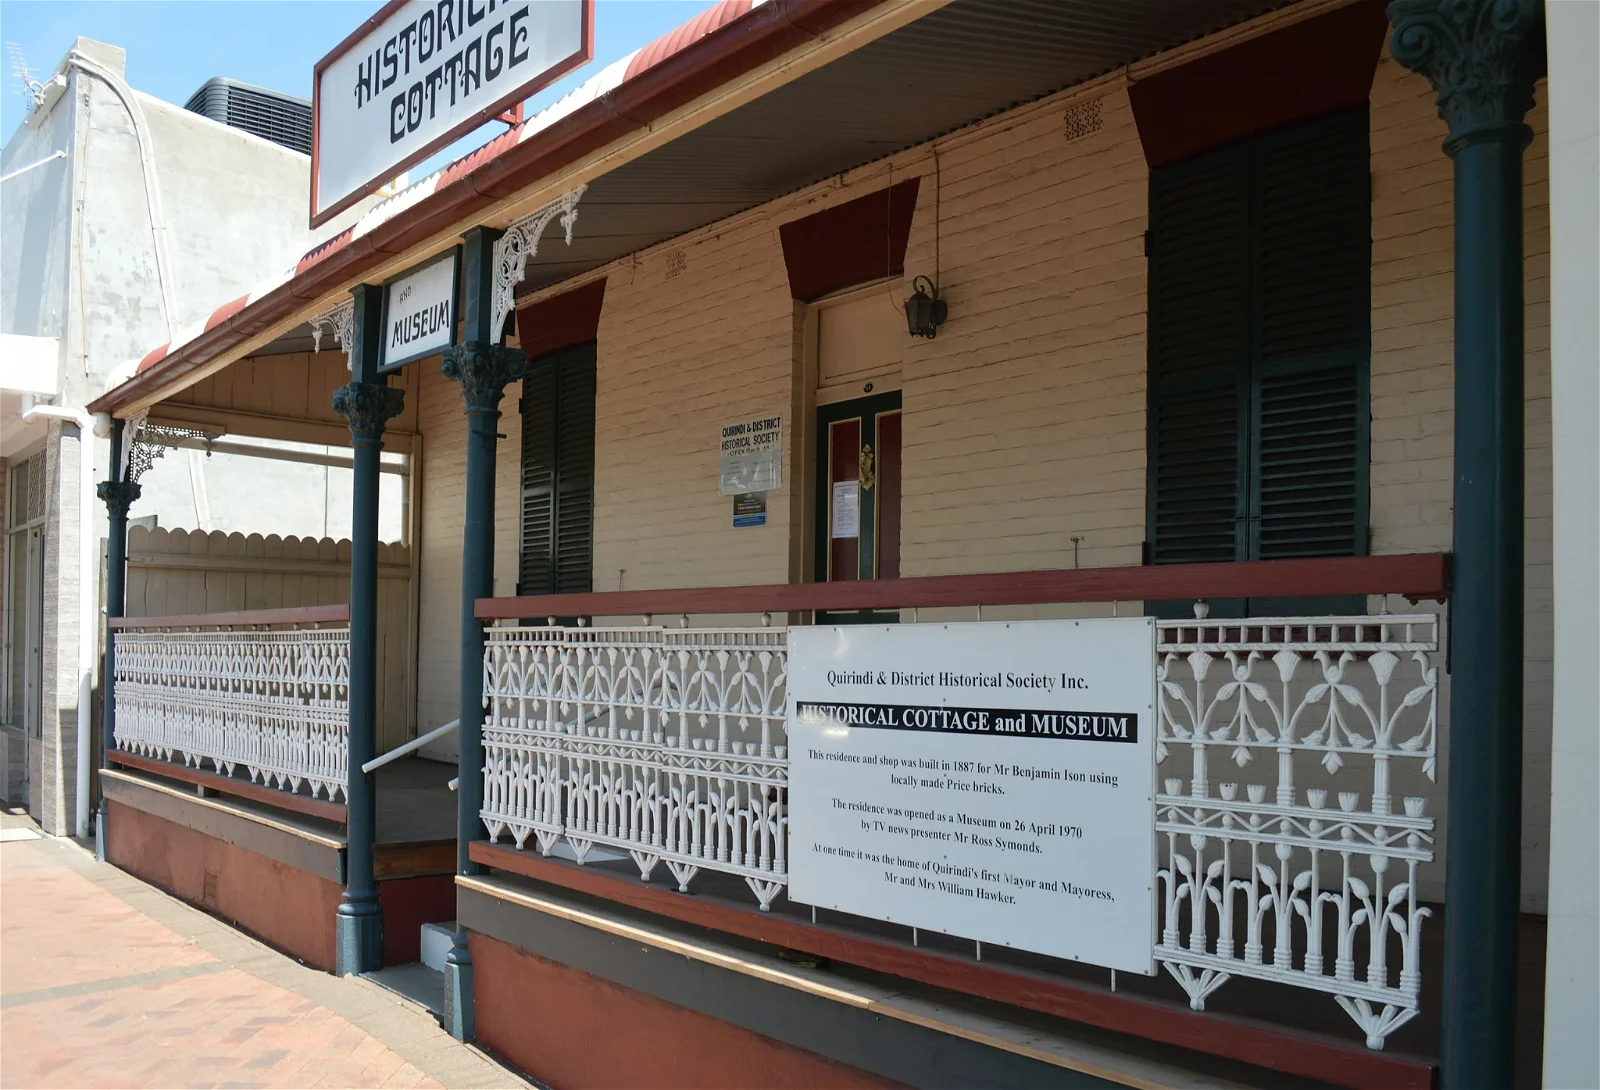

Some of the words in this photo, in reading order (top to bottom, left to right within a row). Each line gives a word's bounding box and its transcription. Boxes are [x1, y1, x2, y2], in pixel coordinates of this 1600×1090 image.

[354, 0, 509, 109] HISTORIC
[390, 5, 530, 144] COTTAGE
[399, 285, 412, 304] AND
[392, 299, 450, 348] MUSEUM
[722, 424, 746, 438] QUIRINDI
[747, 424, 752, 432] &
[752, 416, 780, 432] DISTRICT
[722, 437, 750, 450] HISTORICAL
[754, 431, 780, 444] SOCIETY
[827, 670, 873, 687] Quirindi
[876, 671, 886, 685] &
[891, 671, 935, 686] District
[939, 672, 1002, 688] Historical
[1006, 672, 1056, 692] Society
[1061, 673, 1089, 690] Inc.
[802, 704, 899, 726] HISTORICAL
[902, 708, 990, 731] COTTAGE
[995, 714, 1026, 733] and
[1031, 714, 1128, 738] MUSEUM
[808, 749, 824, 760] This
[826, 751, 860, 764] residence
[862, 754, 878, 764] and
[880, 755, 898, 769] shop
[900, 760, 916, 768] was
[919, 758, 939, 770] built
[942, 760, 950, 771] in
[953, 761, 974, 773] 1887
[977, 763, 992, 774] for
[994, 764, 1010, 776] Mr
[1012, 765, 1060, 780] Benjamin
[1064, 769, 1086, 782] Ison
[1090, 772, 1118, 788] using
[891, 774, 918, 789] locally
[920, 778, 944, 789] made
[947, 779, 970, 792] Price
[973, 780, 1005, 795] bricks.
[832, 798, 846, 810] The
[848, 801, 884, 814] residence
[887, 807, 902, 816] was
[904, 808, 934, 820] opened
[937, 814, 946, 822] as
[948, 814, 954, 823] a
[957, 813, 996, 828] Museum
[1000, 821, 1011, 830] on
[1014, 820, 1026, 832] 26
[1029, 822, 1055, 836] April
[1059, 825, 1082, 839] 1970
[861, 820, 870, 832] by
[873, 820, 886, 832] TV
[888, 825, 908, 836] news
[911, 827, 951, 841] presenter
[954, 831, 968, 844] Mr
[972, 834, 992, 847] Ross
[996, 837, 1043, 854] Symonds.
[812, 842, 821, 852] At
[823, 846, 836, 856] one
[838, 847, 855, 858] time
[857, 849, 862, 860] it
[865, 853, 880, 863] was
[882, 854, 895, 865] the
[897, 856, 920, 869] home
[922, 861, 931, 871] of
[932, 862, 978, 879] Quirindi's
[981, 869, 1000, 882] first
[1004, 872, 1036, 889] Mayor
[1039, 881, 1058, 892] and
[1061, 882, 1115, 902] Mayoress,
[884, 871, 898, 883] Mr
[900, 877, 915, 887] and
[918, 877, 936, 891] Mrs
[938, 881, 973, 897] William
[976, 887, 1016, 904] Hawker.
